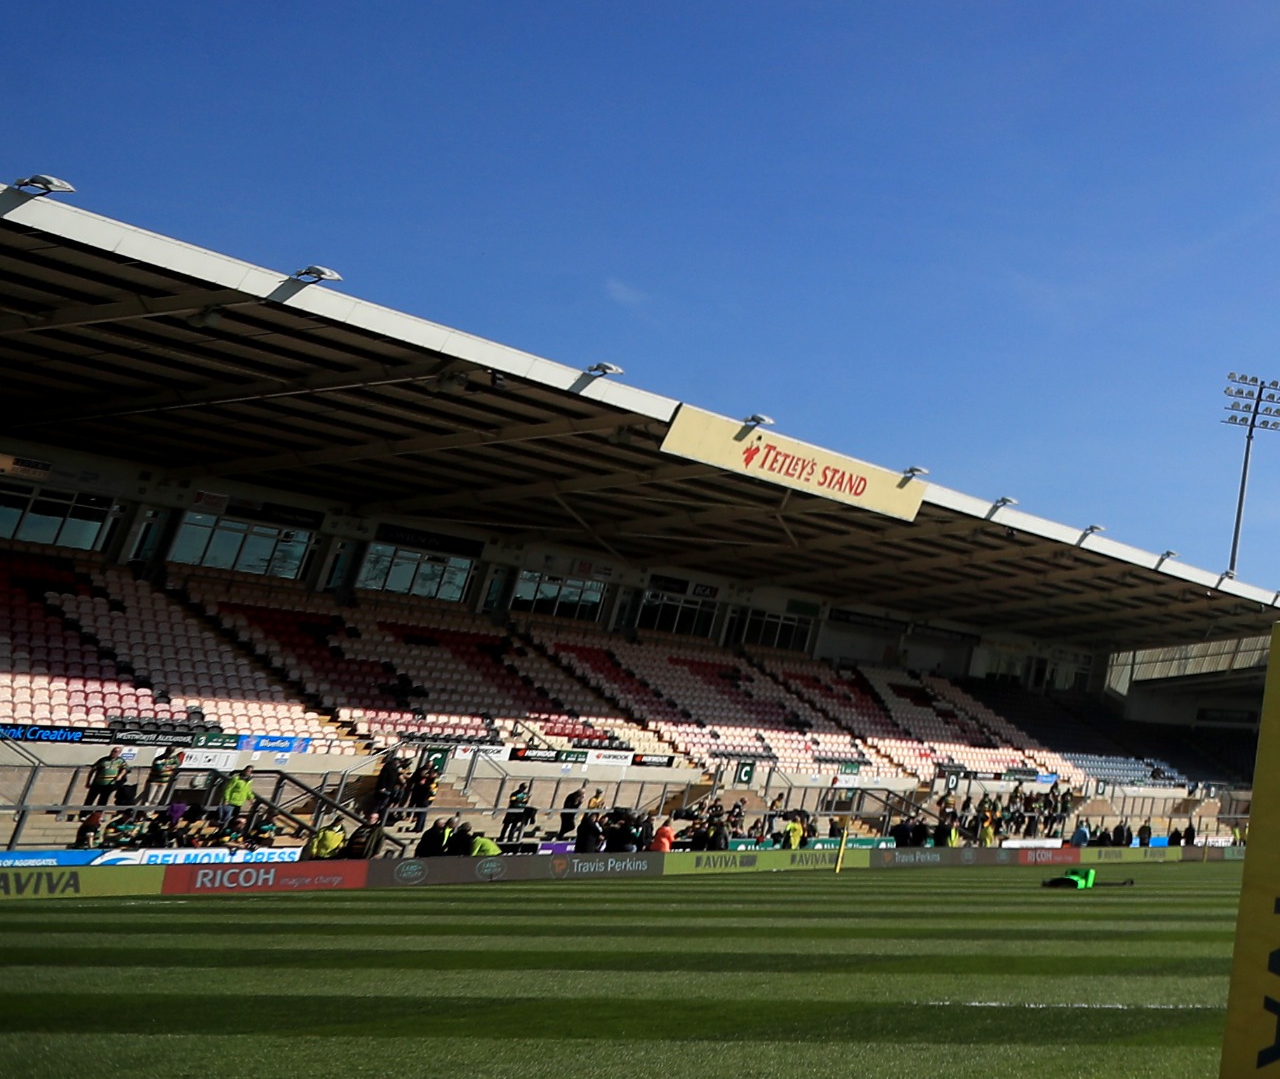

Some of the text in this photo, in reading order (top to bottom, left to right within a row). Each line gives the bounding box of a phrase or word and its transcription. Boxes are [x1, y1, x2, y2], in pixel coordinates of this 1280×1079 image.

[759, 443, 867, 497] TETLEY'S STAND
[27, 727, 83, 741] Creative
[199, 736, 206, 746] 3
[561, 753, 566, 761] 4
[741, 766, 750, 782] C
[949, 775, 957, 788] D
[244, 851, 297, 863] PRESS
[704, 855, 737, 868] AVIVA
[799, 853, 827, 865] AVIVA
[895, 851, 940, 863] Travis Perkins
[1027, 851, 1052, 862] RICOH
[573, 858, 648, 872] Travis Perkins
[0, 871, 80, 895] AVIVA
[196, 868, 276, 888] RICOH
